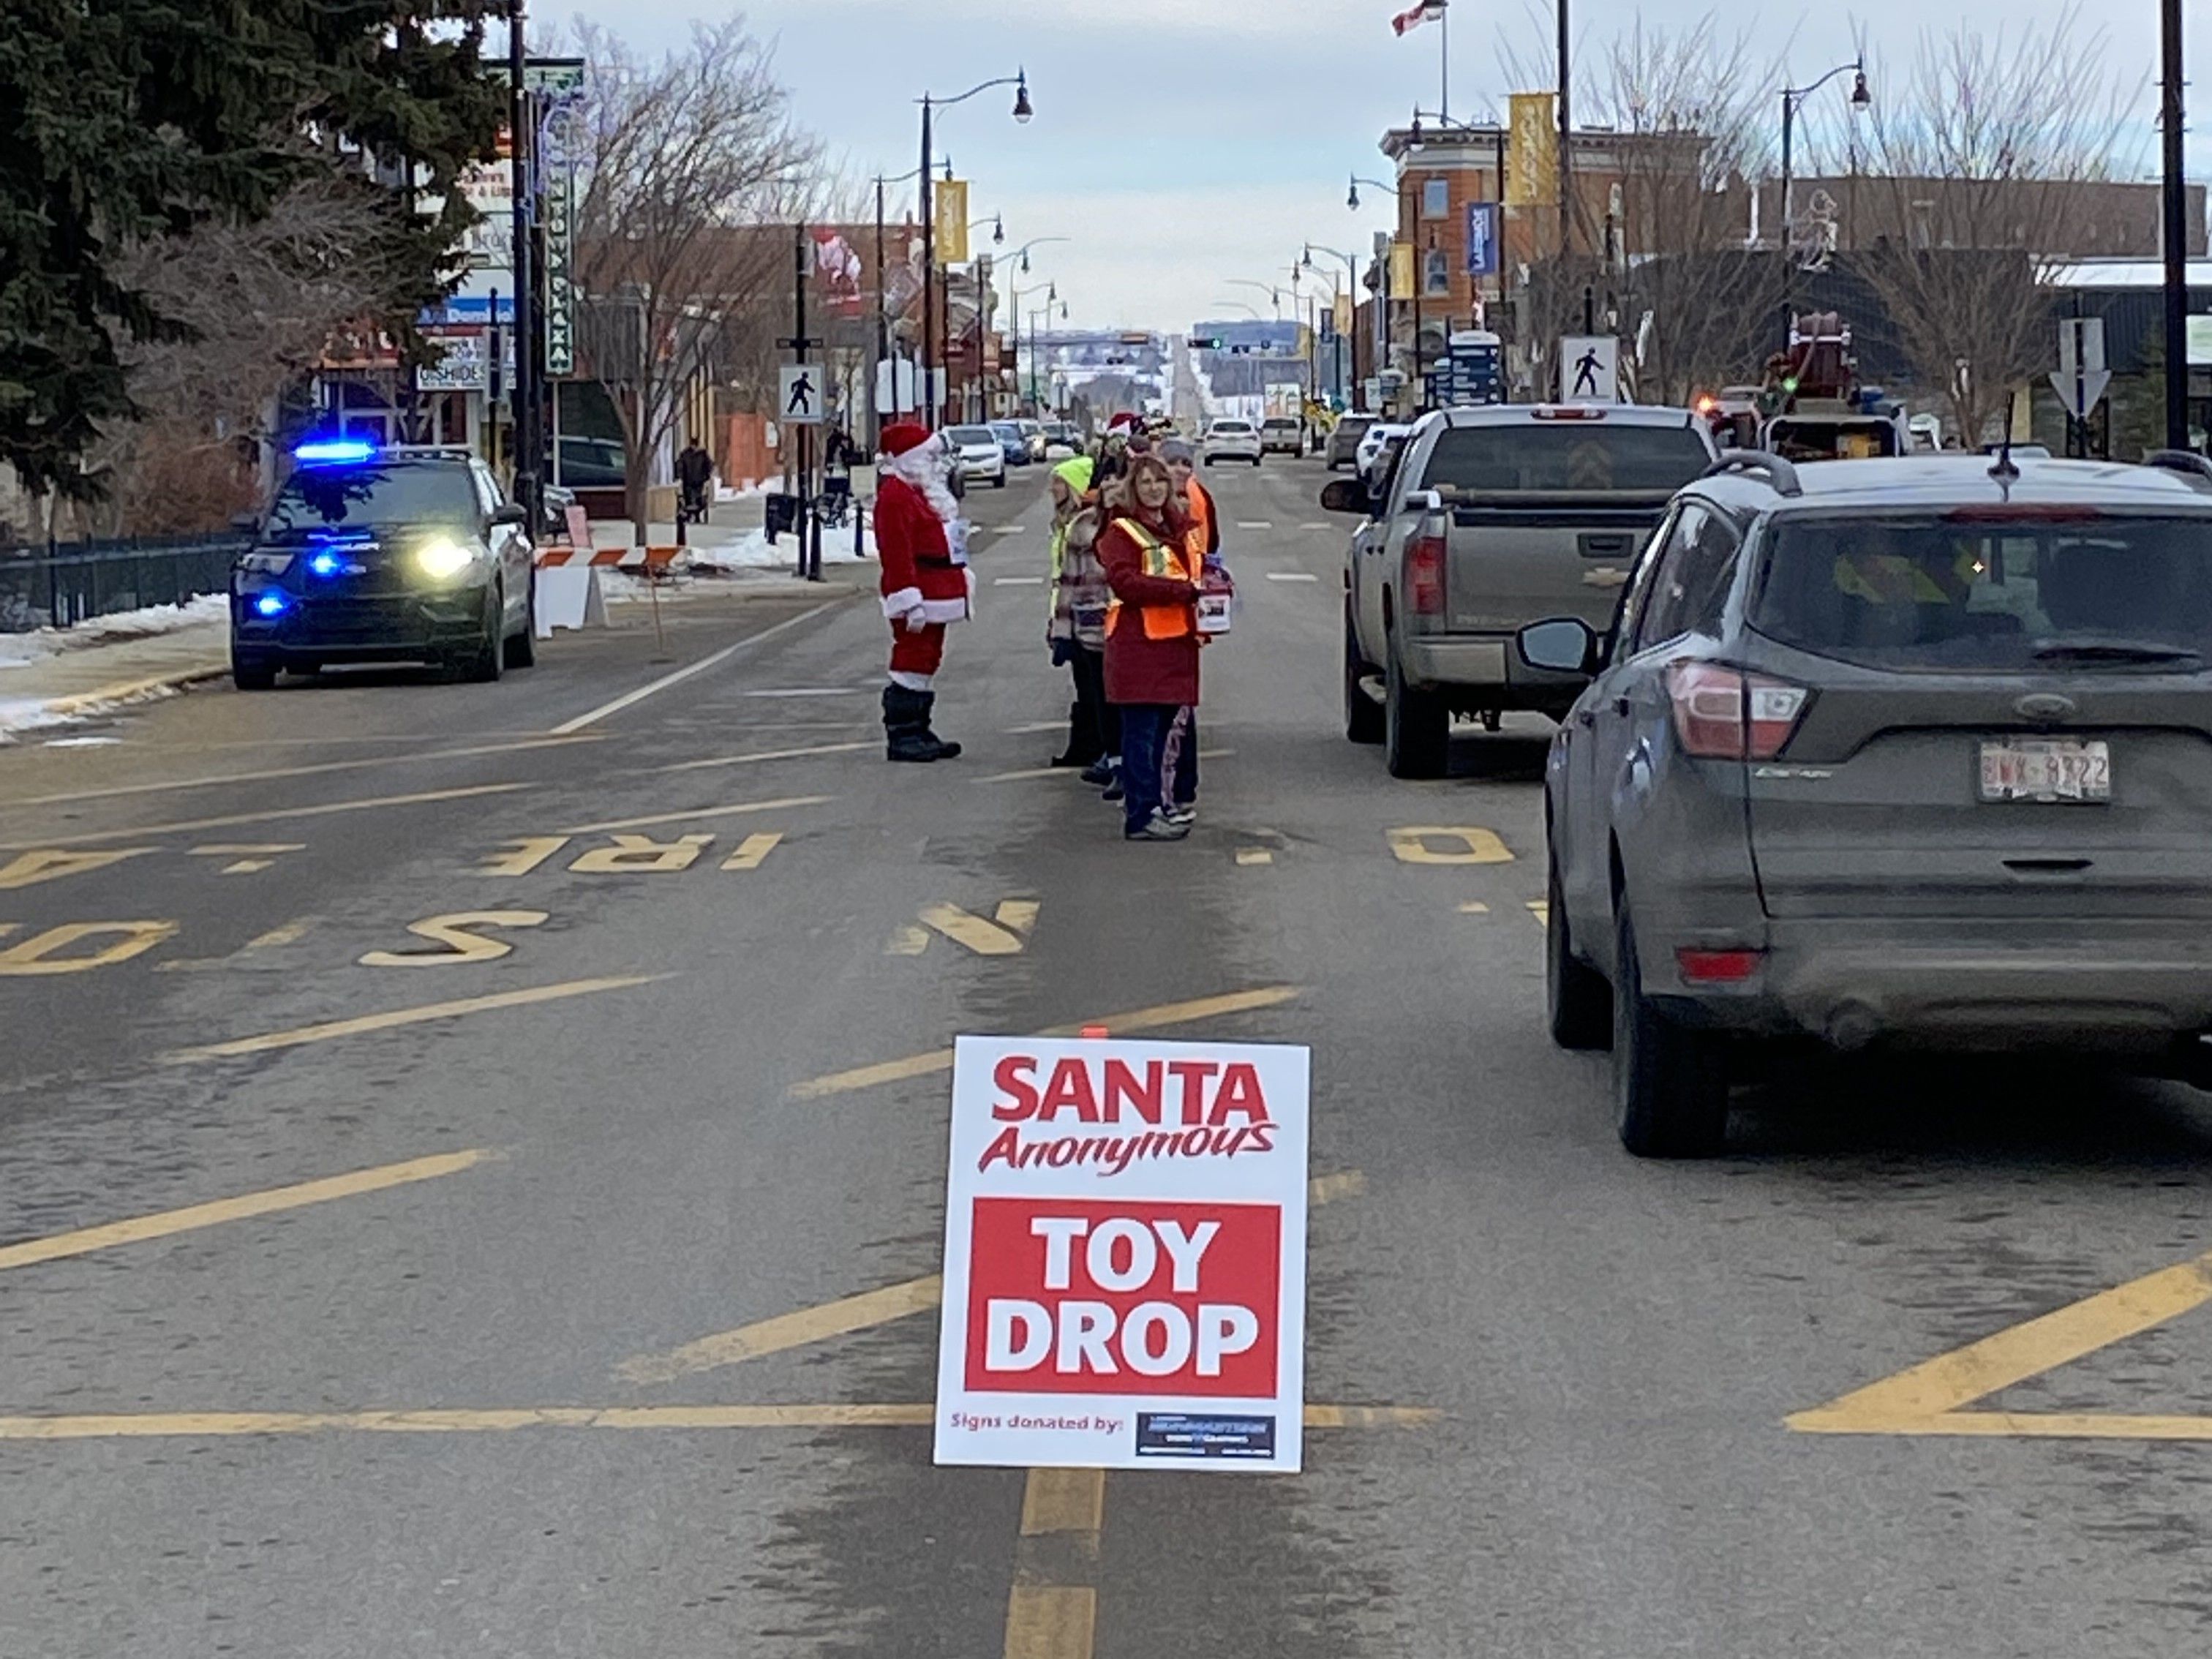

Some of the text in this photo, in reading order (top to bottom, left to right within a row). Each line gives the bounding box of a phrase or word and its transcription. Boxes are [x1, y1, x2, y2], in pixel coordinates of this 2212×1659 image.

[992, 1056, 1270, 1126] SANTA
[977, 1124, 1279, 1176] Anonymous
[1031, 1217, 1221, 1293] TOY
[985, 1299, 1260, 1377] DROP
[951, 1412, 1001, 1431] Signs
[1007, 1415, 1089, 1430] donated
[1094, 1415, 1124, 1435] by:
